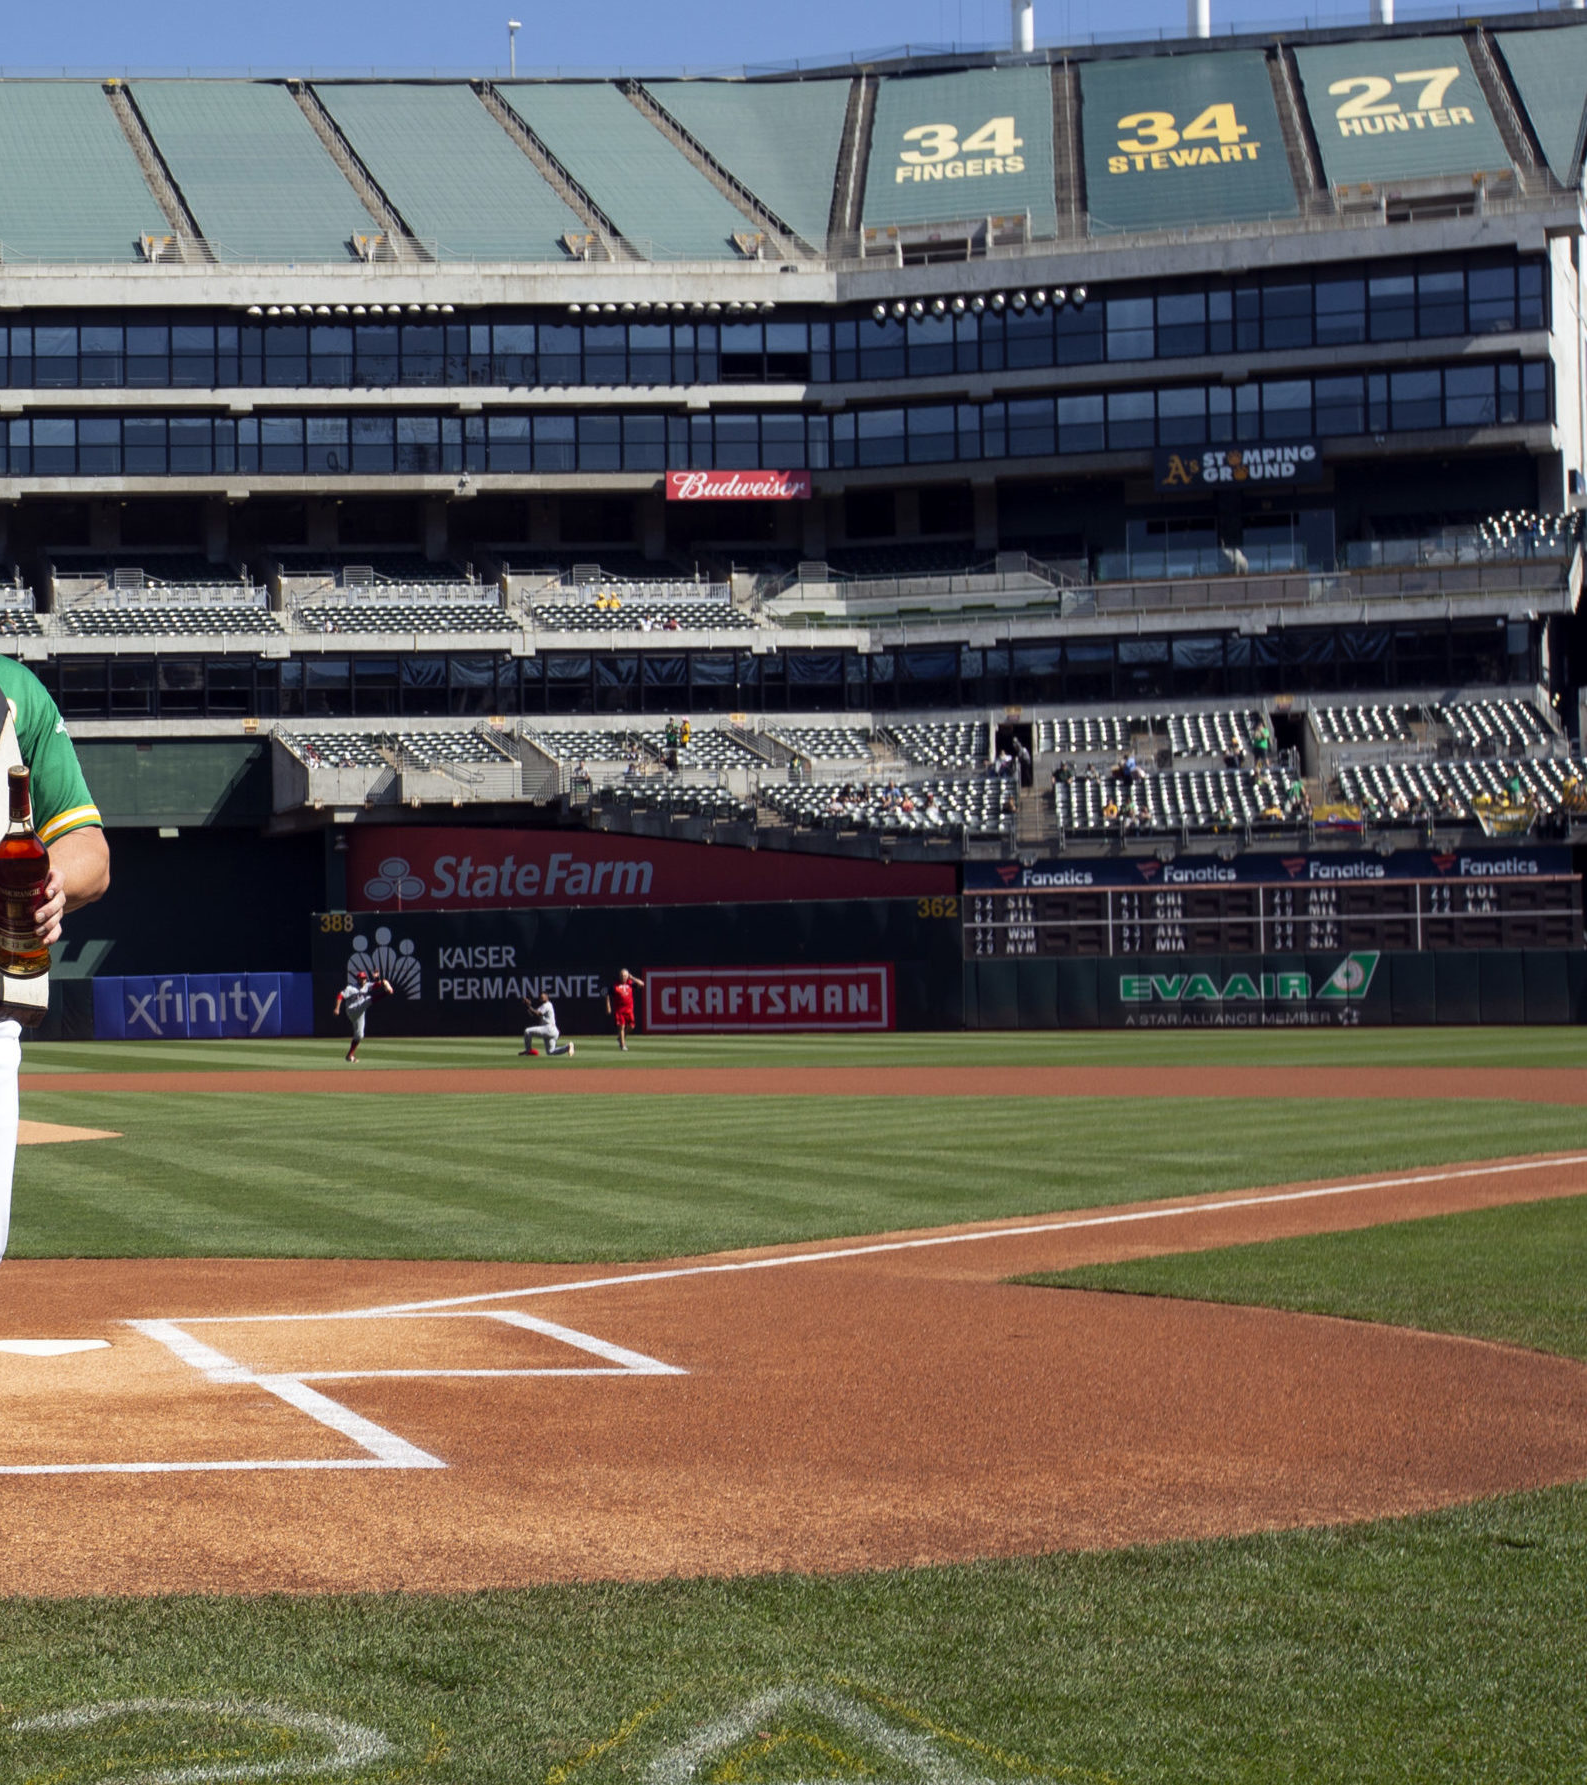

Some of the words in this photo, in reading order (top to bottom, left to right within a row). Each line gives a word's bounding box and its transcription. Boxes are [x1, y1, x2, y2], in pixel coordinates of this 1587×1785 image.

[1328, 66, 1461, 120] 27
[1117, 103, 1249, 153] 34
[1338, 106, 1475, 138] HUNTER
[900, 117, 1024, 165] 34
[896, 155, 1025, 184] FINGERS
[1108, 142, 1262, 175] STEWART
[1162, 454, 1200, 485] A's
[673, 472, 805, 499] Budweiser
[1022, 869, 1093, 886] Fanatics
[1164, 865, 1236, 882] Fanatics
[1309, 861, 1385, 879] Fanatics
[1461, 857, 1538, 875] Fanatics
[917, 899, 958, 919] 362
[321, 914, 353, 932] 388
[438, 946, 516, 969] KAISER
[438, 974, 600, 1000] PERMANENTE
[661, 984, 869, 1015] CRAFTSMAN
[128, 979, 278, 1036] xfinity
[1125, 1014, 1136, 1026] A
[1140, 1013, 1179, 1026] STAR
[1182, 1012, 1257, 1026] ALLIANCE
[1261, 1011, 1331, 1025] MEMBER
